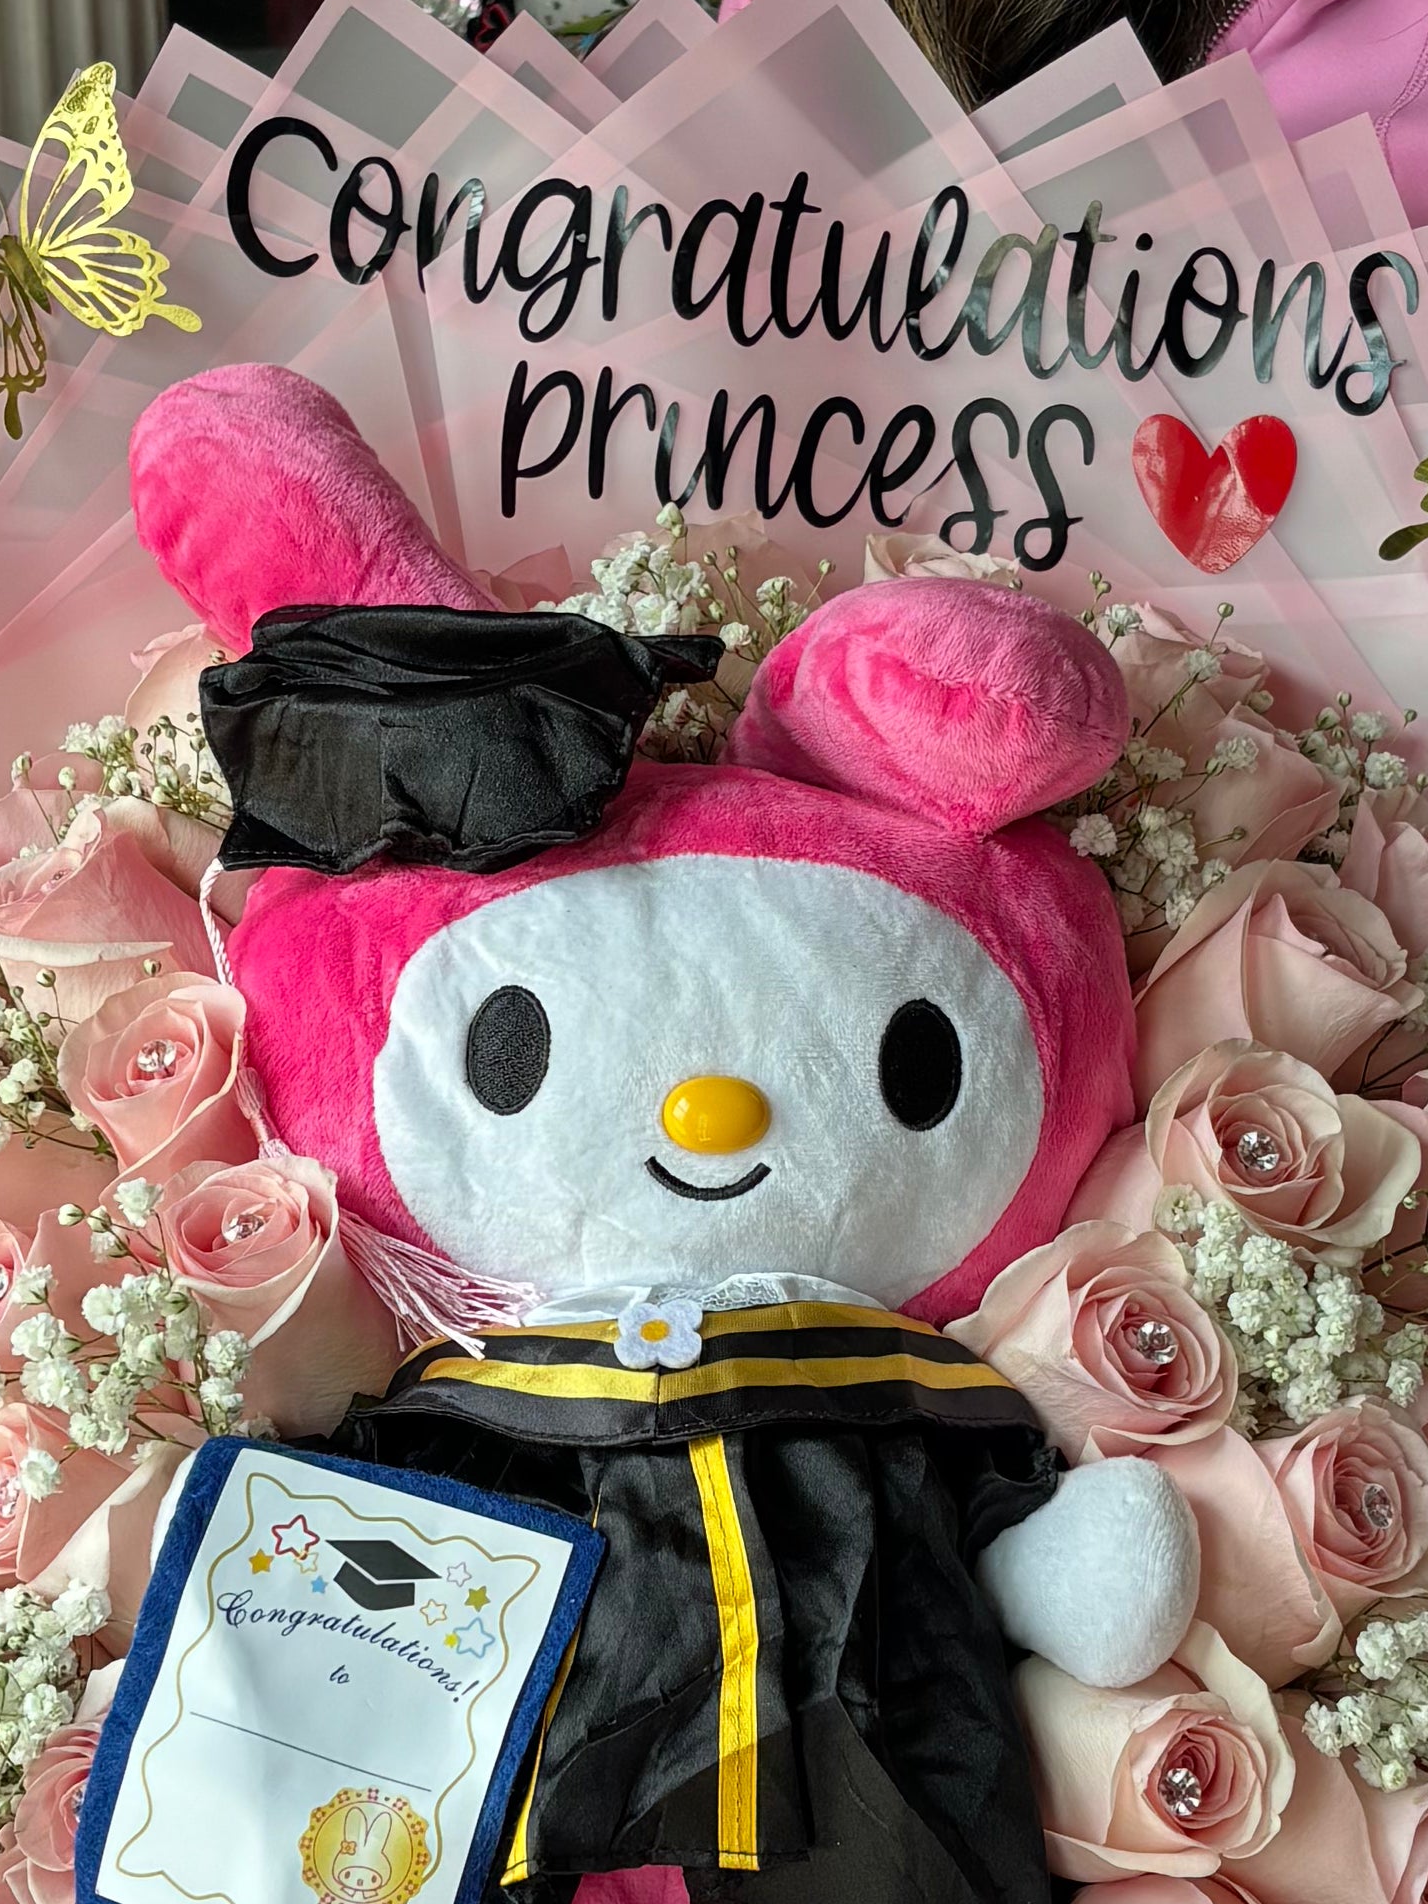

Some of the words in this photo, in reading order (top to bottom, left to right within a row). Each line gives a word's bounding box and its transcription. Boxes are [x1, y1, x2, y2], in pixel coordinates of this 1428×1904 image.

[226, 115, 1422, 419] Congratulations
[216, 1589, 479, 1704] Congratulations!
[329, 1662, 352, 1686] to
